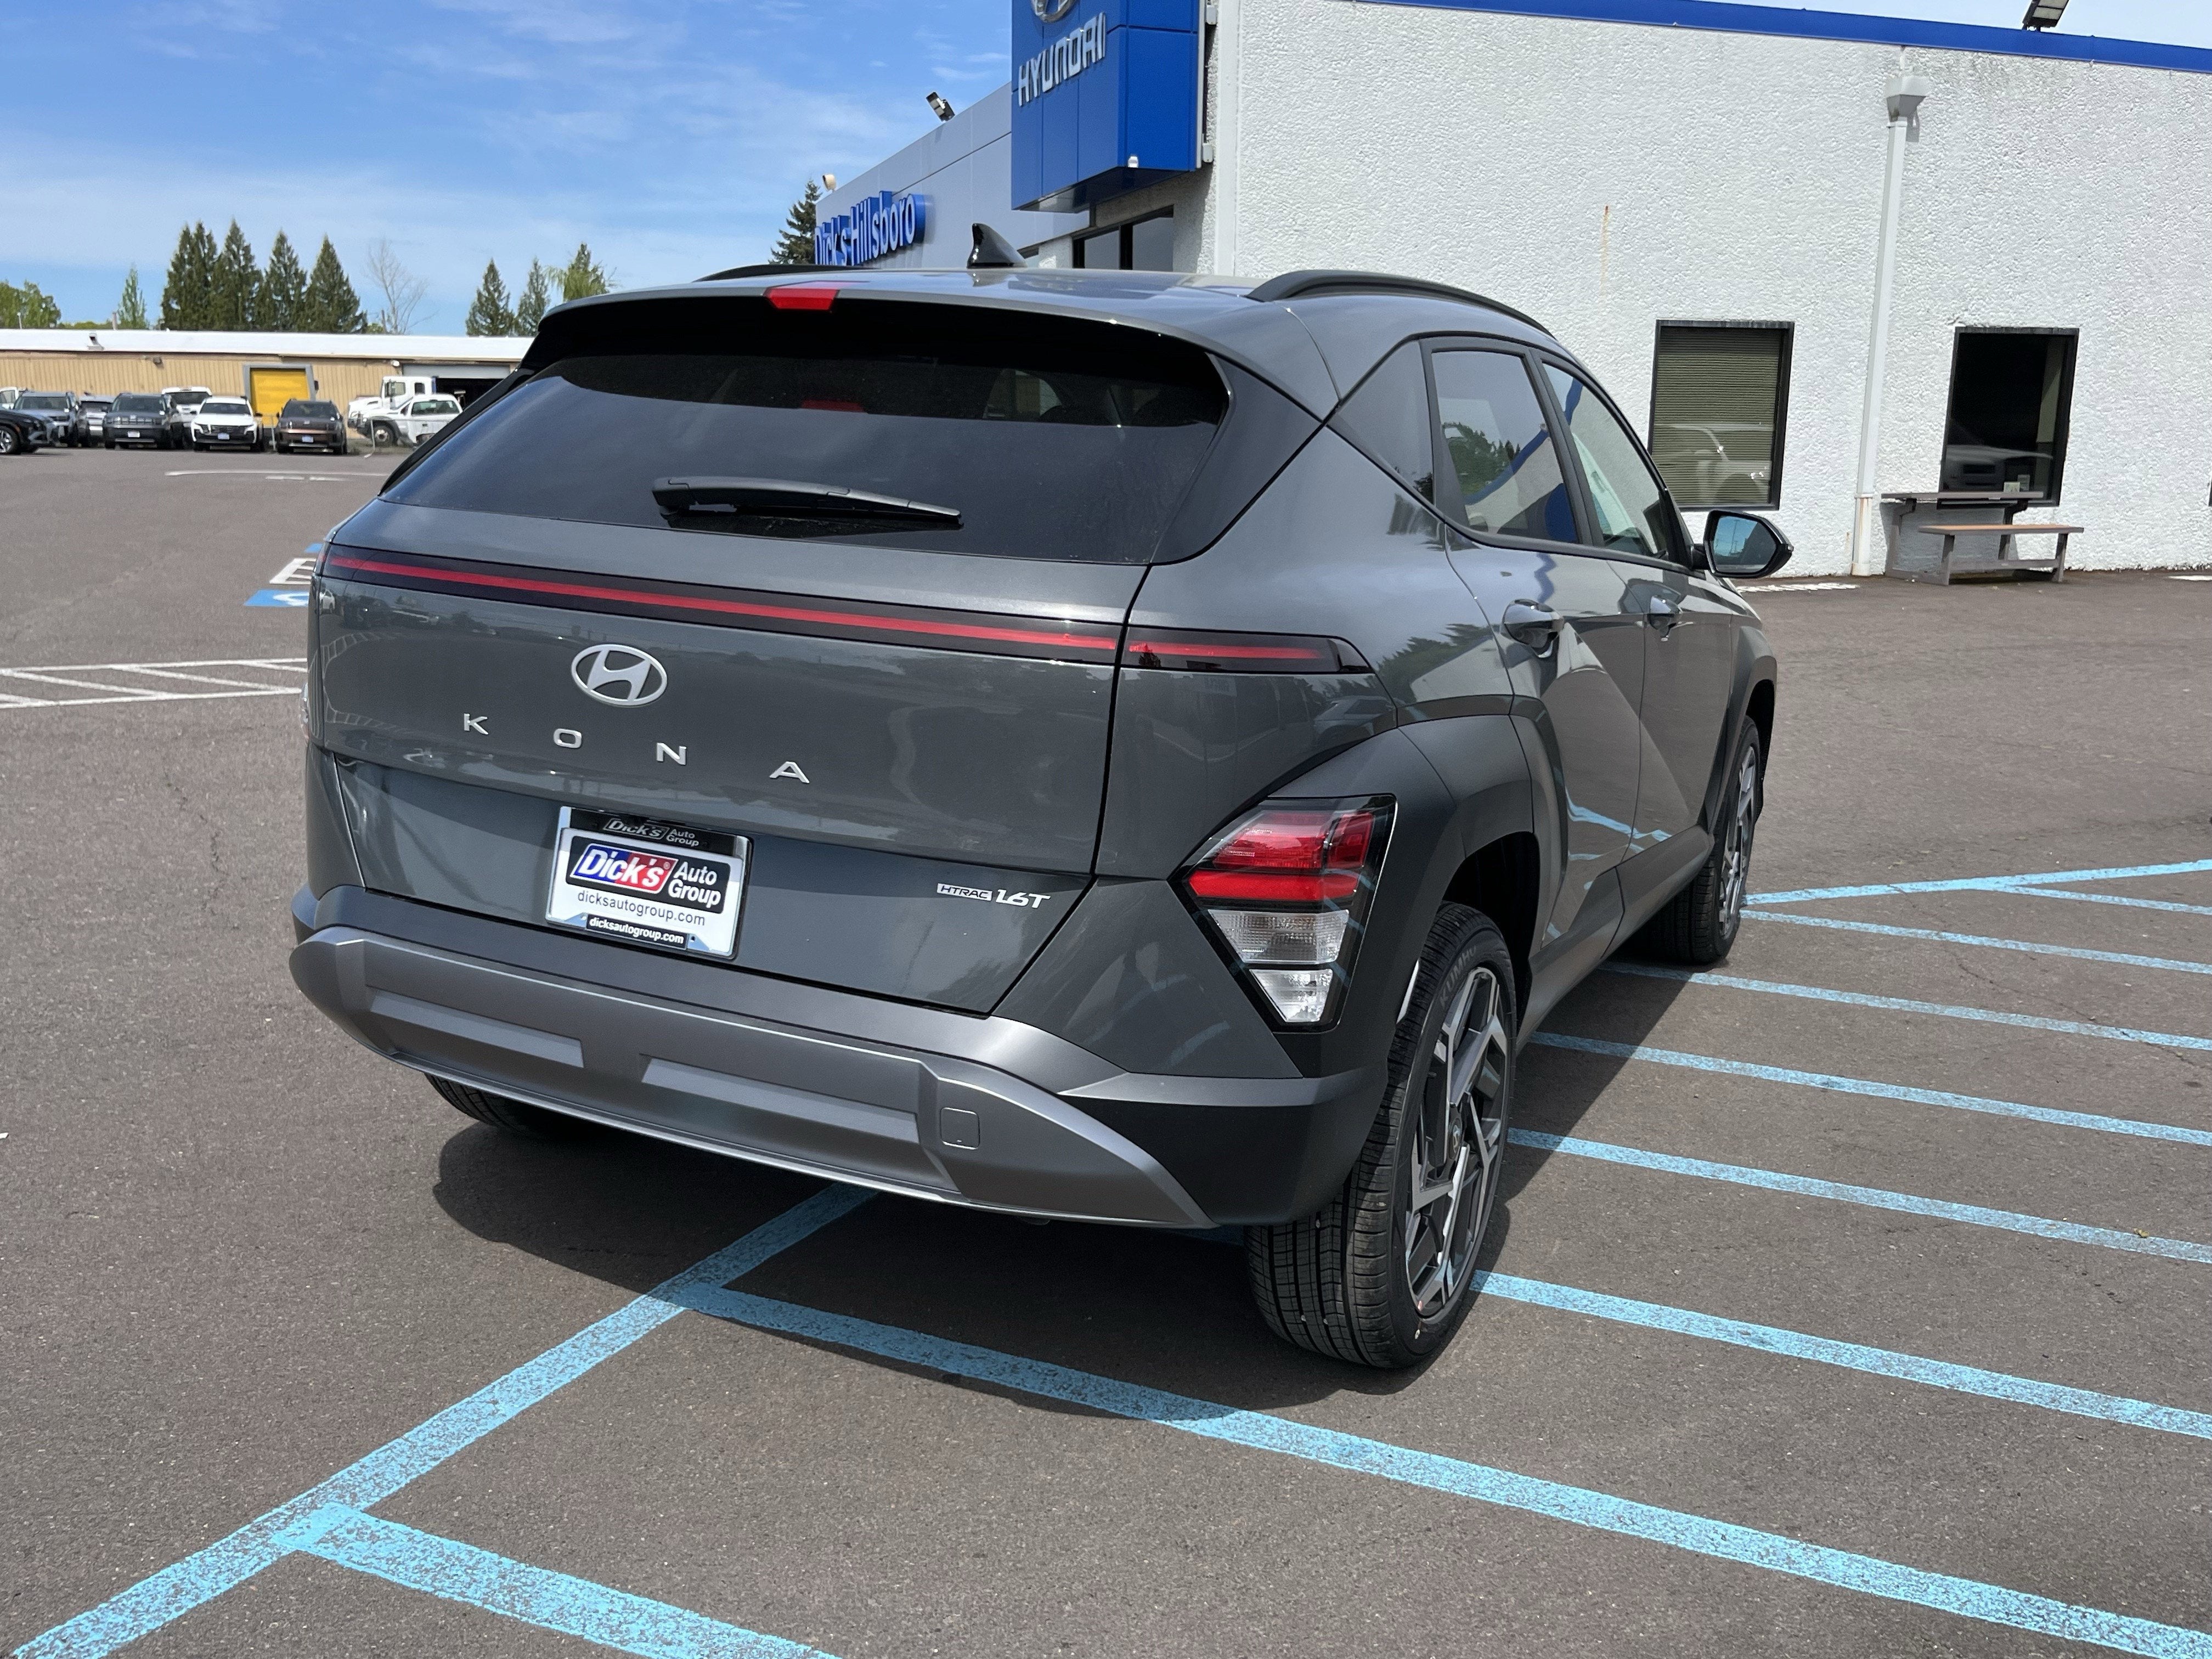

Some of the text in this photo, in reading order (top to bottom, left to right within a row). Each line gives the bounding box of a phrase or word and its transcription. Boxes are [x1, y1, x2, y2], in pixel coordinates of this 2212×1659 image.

[1019, 12, 1106, 106] HYUNDAI
[851, 191, 919, 266] Hillsboro
[665, 834, 699, 848] Group
[671, 828, 695, 839] Auto
[673, 861, 718, 886] Auto
[668, 879, 721, 909] Group
[940, 884, 988, 899] HTRAC
[577, 890, 706, 926] dicksautogroup.com
[589, 917, 684, 945] dicksautogroup.com
